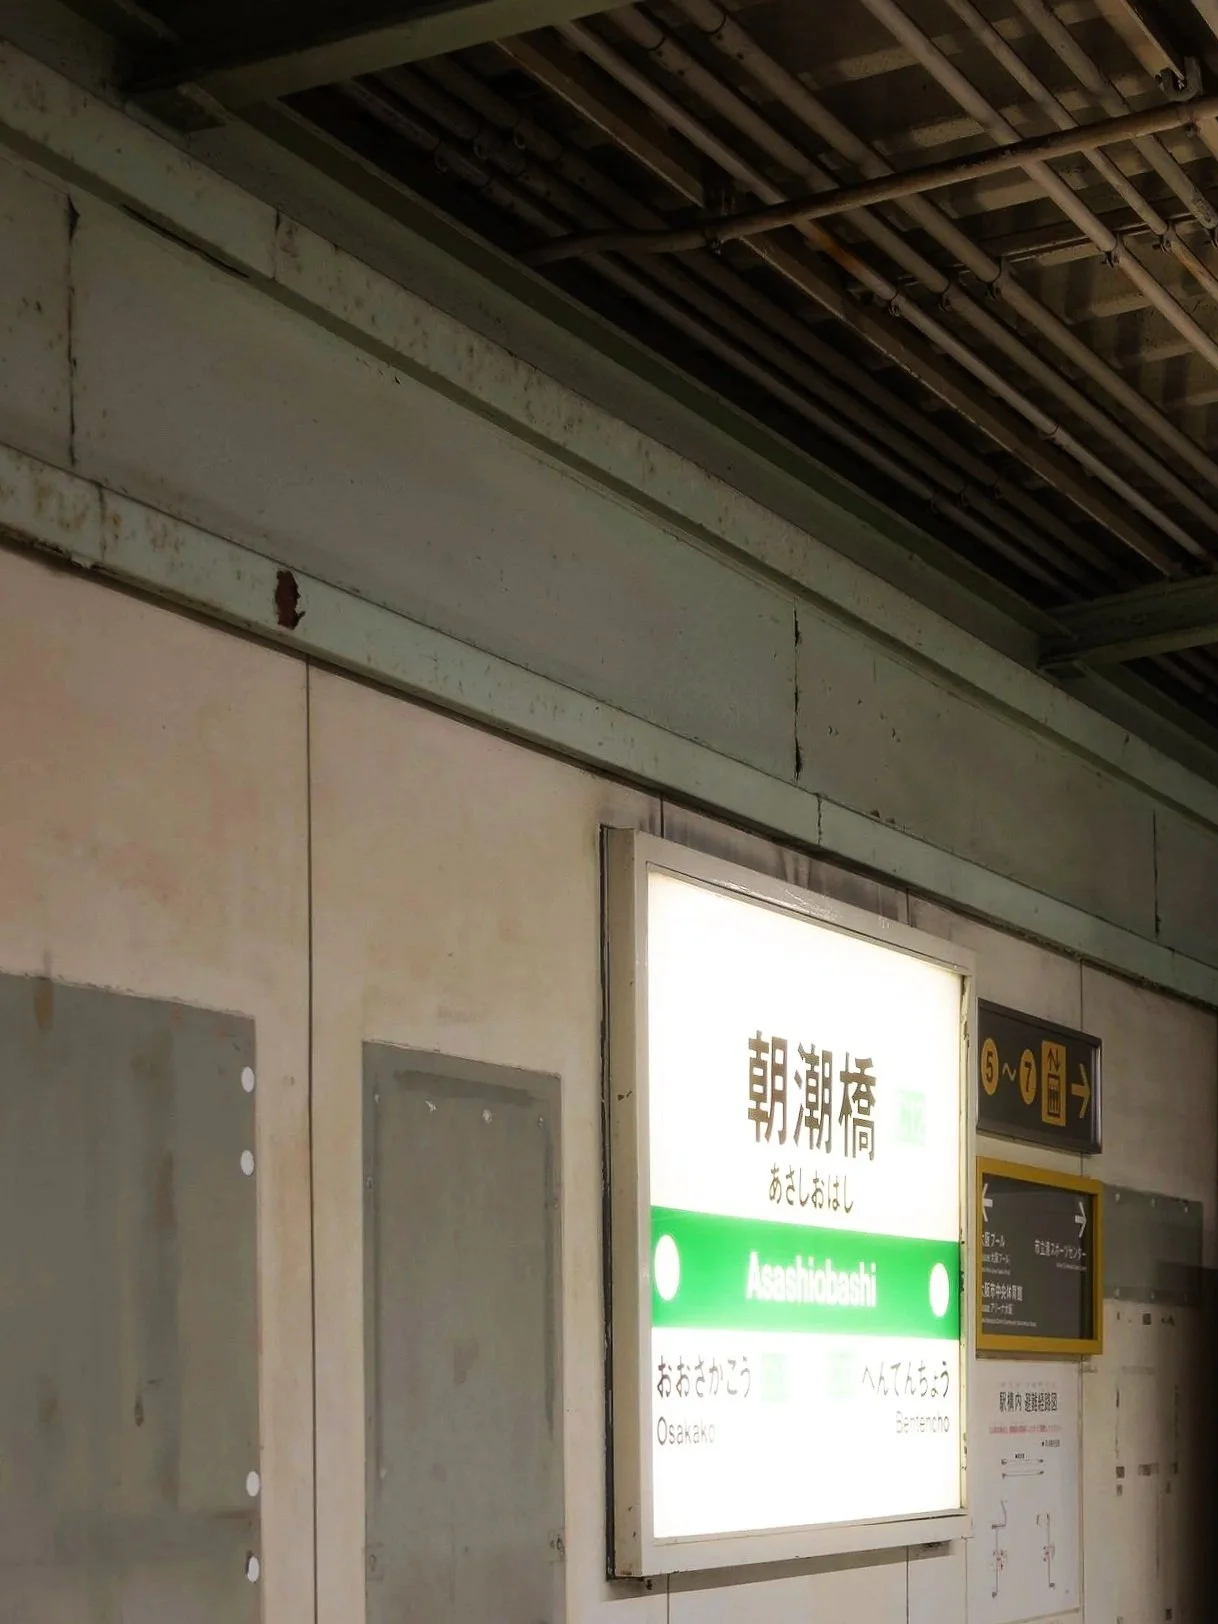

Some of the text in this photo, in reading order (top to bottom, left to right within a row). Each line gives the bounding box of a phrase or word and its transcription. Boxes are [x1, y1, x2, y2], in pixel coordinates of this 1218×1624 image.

[747, 1029, 878, 1162] 朝潮橋
[746, 1251, 878, 1308] Asashiobashi
[656, 1354, 752, 1399] おおさかこう
[656, 1415, 717, 1447] Osakako
[894, 1409, 951, 1436] Bentencho
